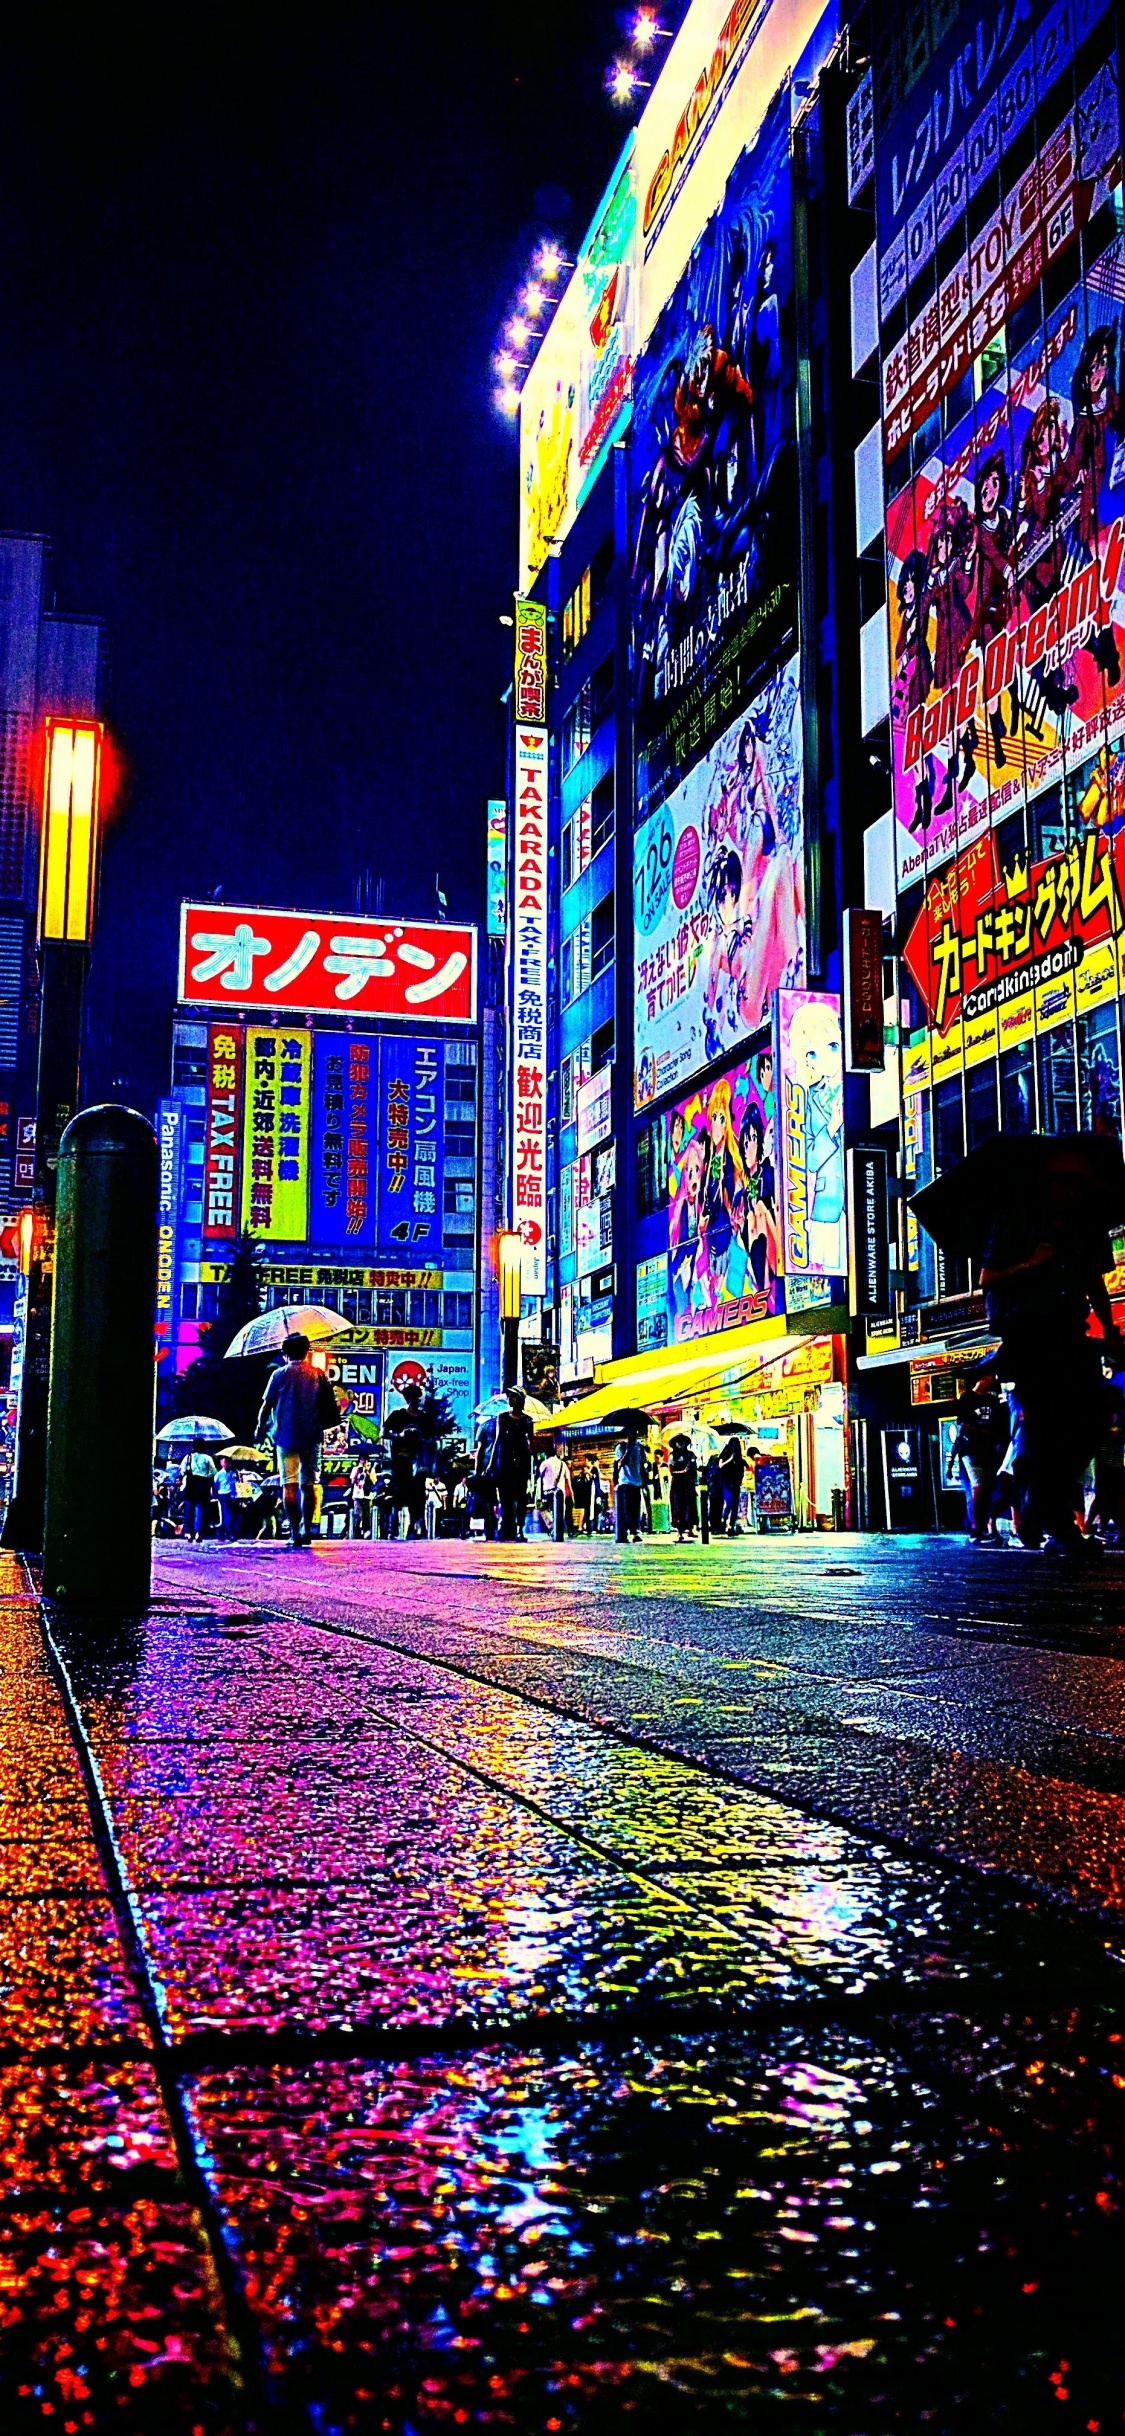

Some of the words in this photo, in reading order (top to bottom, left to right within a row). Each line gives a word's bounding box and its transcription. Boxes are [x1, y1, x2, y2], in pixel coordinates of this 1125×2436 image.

[1050, 200, 1072, 249] 6F
[519, 626, 544, 719] まんが喫茶
[519, 767, 543, 911] TAKARADA
[643, 903, 656, 931] ON
[654, 869, 672, 909] SALE
[931, 832, 1124, 1026] カードキングダム
[190, 923, 468, 1004] オノデン
[637, 912, 710, 995] 冴えない彼女の
[517, 988, 544, 1060] 免税商店
[212, 1033, 236, 1090] 免税
[210, 1094, 236, 1148] TAX
[322, 1055, 345, 1208] お見積り無料です
[516, 1064, 543, 1208] 歓迎光臨
[160, 1112, 179, 1213] Panasonic
[207, 1153, 234, 1227] FREE
[786, 1074, 809, 1269] GAMERS
[865, 1161, 874, 1196] AKIBA
[390, 1220, 431, 1243] 4F
[866, 1198, 875, 1232] STORE
[157, 1225, 174, 1310] ONODEN
[316, 1271, 365, 1286] 免税店
[867, 1232, 877, 1304] ALIENWARE
[675, 1287, 773, 1343] GAMERS
